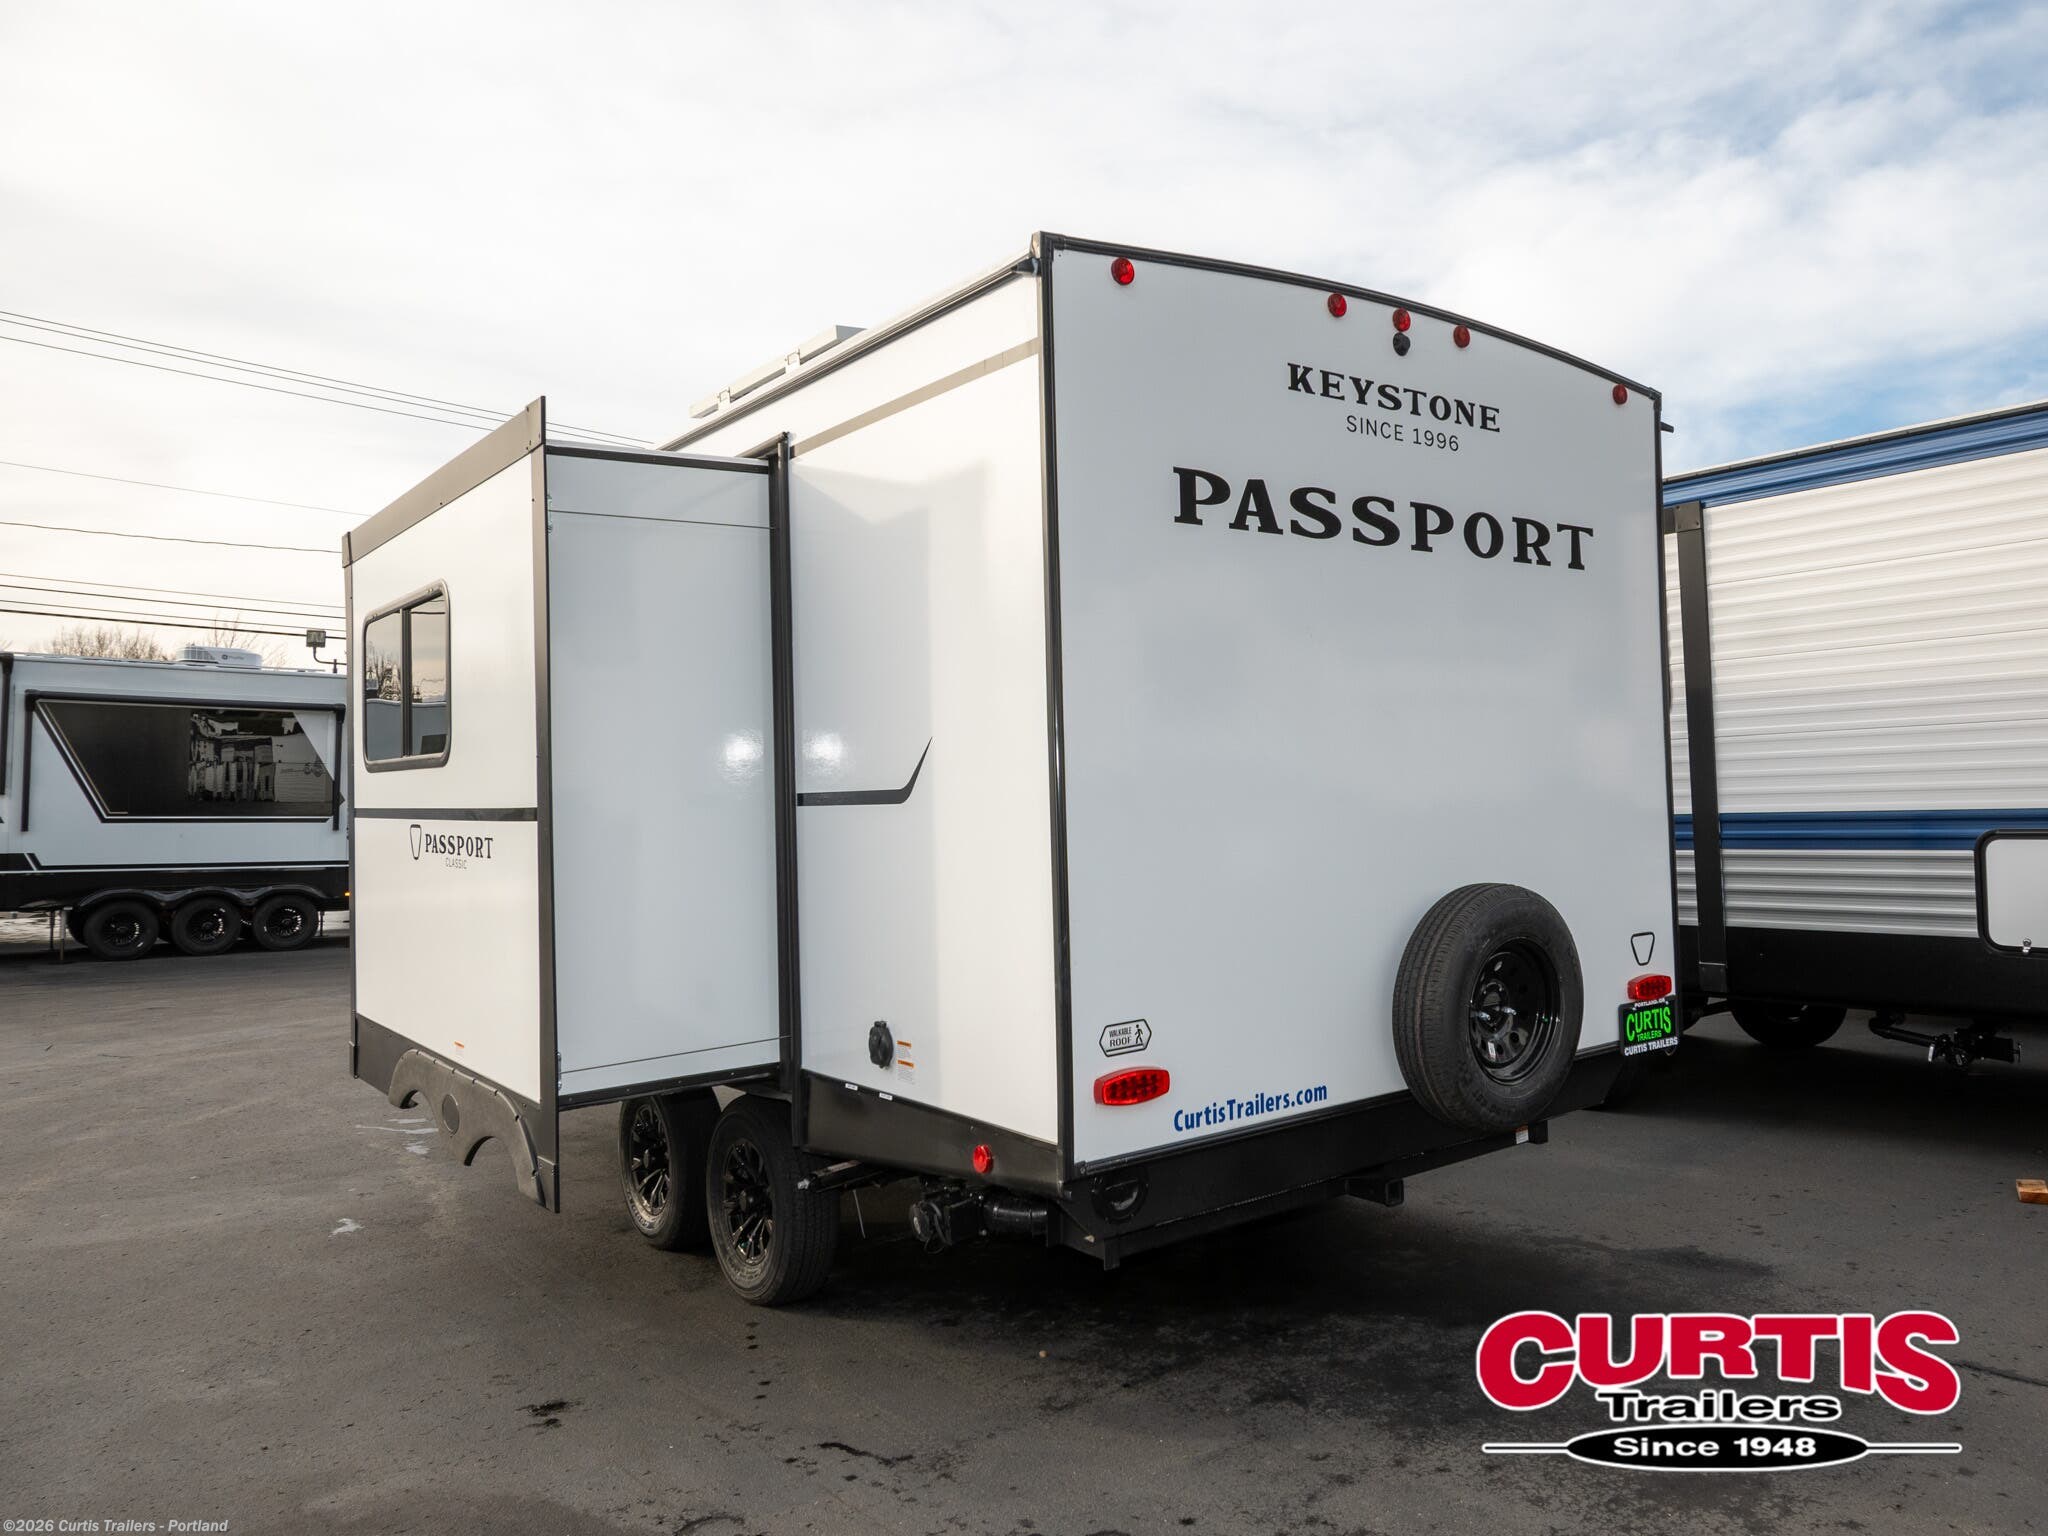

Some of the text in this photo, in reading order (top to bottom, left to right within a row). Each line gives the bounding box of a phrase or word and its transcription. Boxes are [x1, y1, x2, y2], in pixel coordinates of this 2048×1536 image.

[1287, 362, 1501, 433] KEYSTONE
[1346, 414, 1460, 452] SINCE 1996
[1173, 466, 1594, 571] PASSPORT
[425, 833, 494, 859] PASSPORT
[1626, 1006, 1671, 1041] CURTIS
[1637, 1030, 1662, 1042] TRAILERS
[1110, 1036, 1132, 1047] ROOF
[1624, 1036, 1679, 1057] CURTIS TRAILERS
[1174, 1084, 1328, 1132] CurtisTrailers.com
